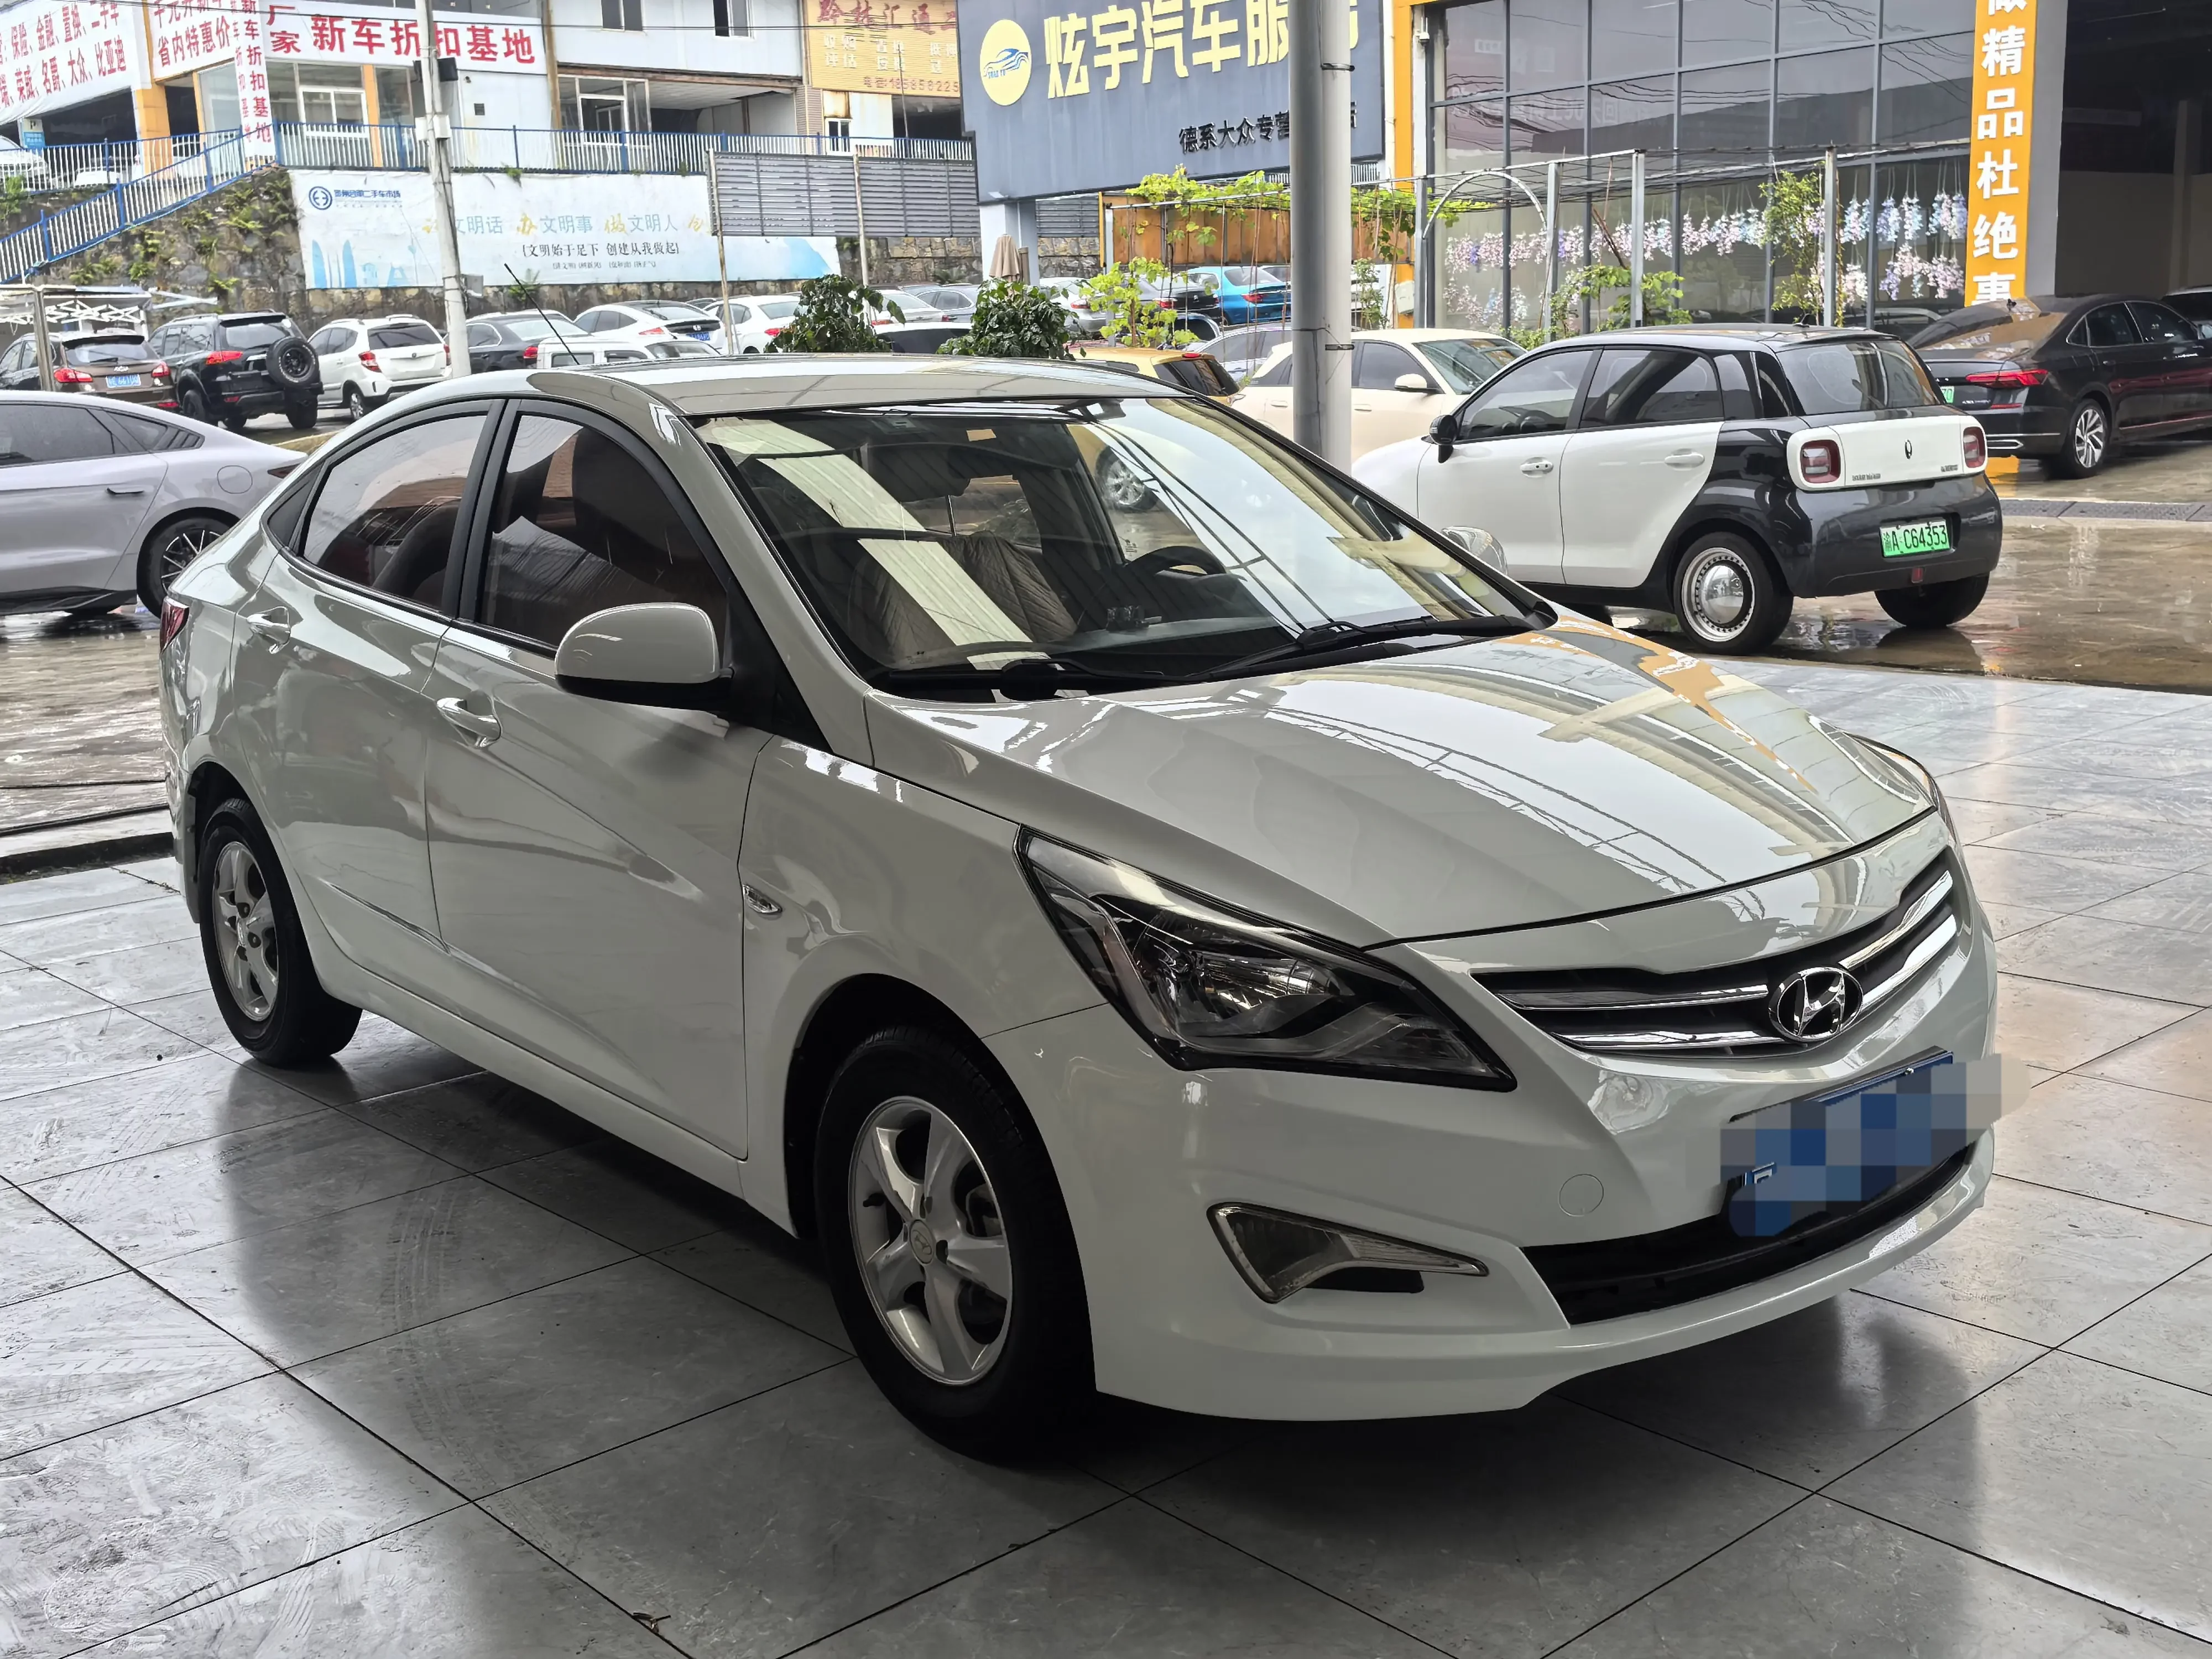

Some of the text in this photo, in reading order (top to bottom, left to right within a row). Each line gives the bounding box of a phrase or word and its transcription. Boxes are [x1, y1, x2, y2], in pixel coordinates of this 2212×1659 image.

[158, 15, 230, 67] 省内特惠价
[266, 4, 301, 54] 厂家
[311, 13, 535, 64] 新车折扣基地
[1044, 0, 1359, 98] 炫宇汽车服
